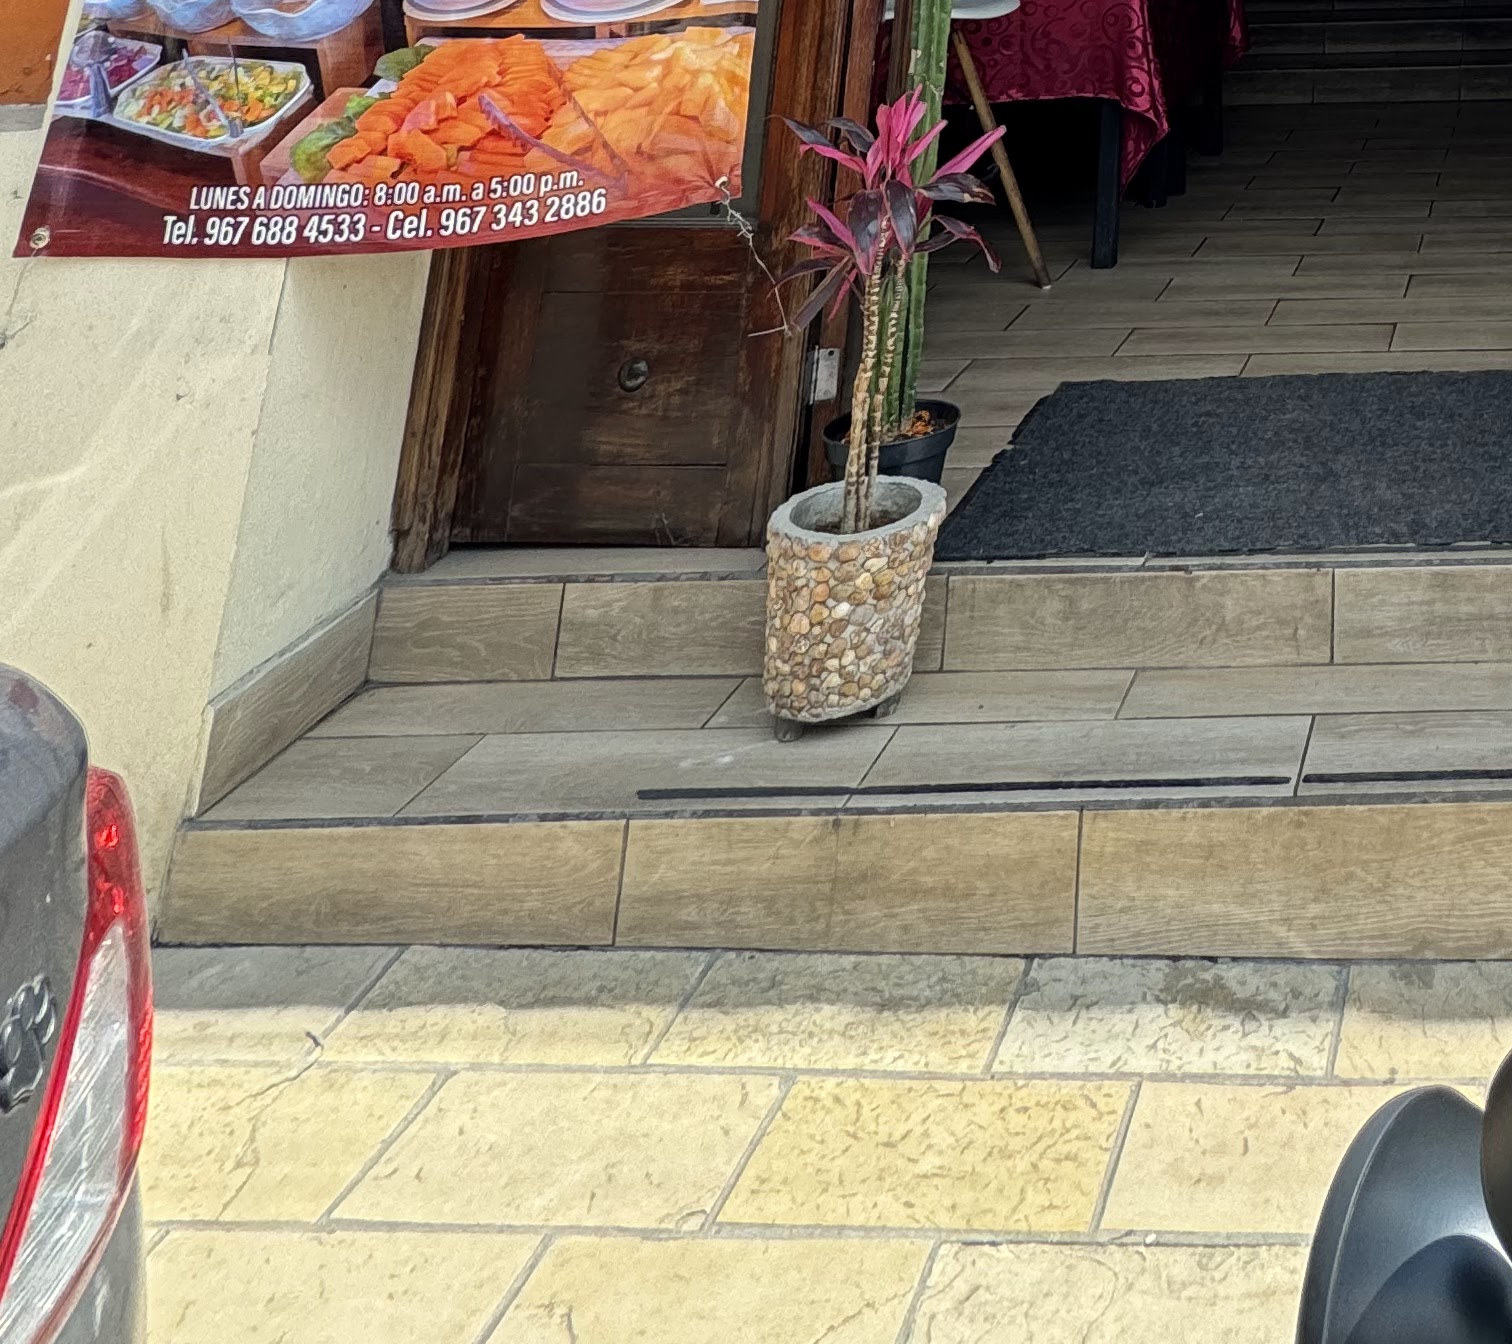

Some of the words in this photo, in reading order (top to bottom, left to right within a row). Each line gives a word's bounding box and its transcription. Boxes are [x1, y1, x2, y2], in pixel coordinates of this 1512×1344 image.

[189, 185, 251, 210] LUNES
[251, 185, 266, 210] A
[269, 183, 369, 210] DOMINGO:
[373, 181, 420, 207] 8:00
[422, 185, 467, 204] a.m.
[470, 182, 485, 201] a
[489, 173, 535, 200] 5:00
[538, 170, 585, 198] p.m.
[162, 214, 199, 245] Tel.
[203, 215, 250, 246] 967
[250, 215, 299, 246] 688
[302, 213, 367, 244] 4533
[385, 208, 433, 240] Cel.
[438, 206, 486, 237] 967
[490, 199, 540, 232] 343
[543, 188, 608, 223] 2886
